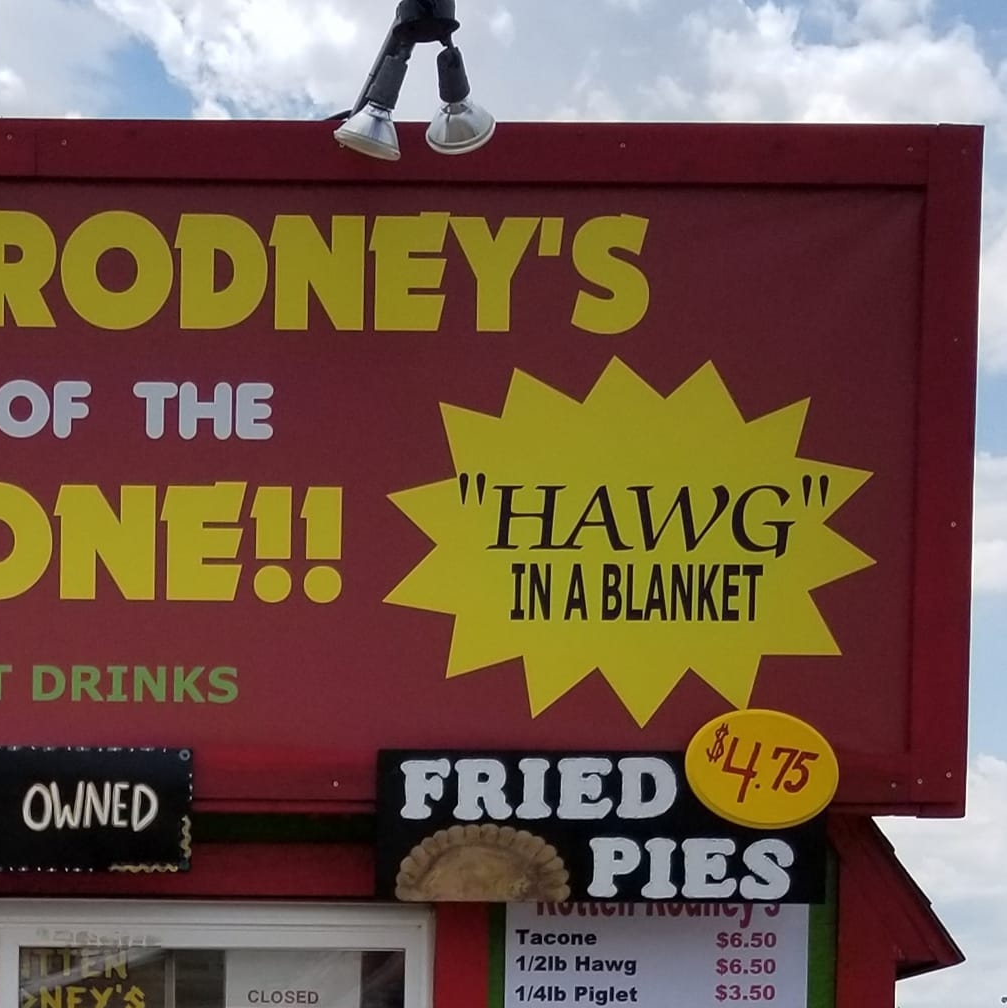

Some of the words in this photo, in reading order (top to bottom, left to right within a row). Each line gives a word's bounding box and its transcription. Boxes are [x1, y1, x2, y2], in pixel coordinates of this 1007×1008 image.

[133, 381, 274, 441] THE
[458, 472, 830, 559] "HAWG"
[509, 563, 553, 622] IN
[564, 563, 589, 622] A
[601, 563, 764, 623] BLANKET
[32, 665, 239, 704] DRINKS
[399, 757, 678, 821] FRIED
[705, 722, 820, 804] $4.75
[22, 781, 159, 832] OWNED
[587, 837, 795, 900] PIES
[515, 929, 597, 946] Tacone
[716, 932, 777, 949] $6.50
[515, 956, 567, 972] 1/2lb
[575, 957, 637, 975] Hawg
[716, 958, 776, 975] $6.50
[247, 989, 320, 1006] CLOSED
[515, 986, 566, 1002] 1/4lb
[575, 986, 638, 1005] Piglet
[715, 985, 776, 1002] $3.50
